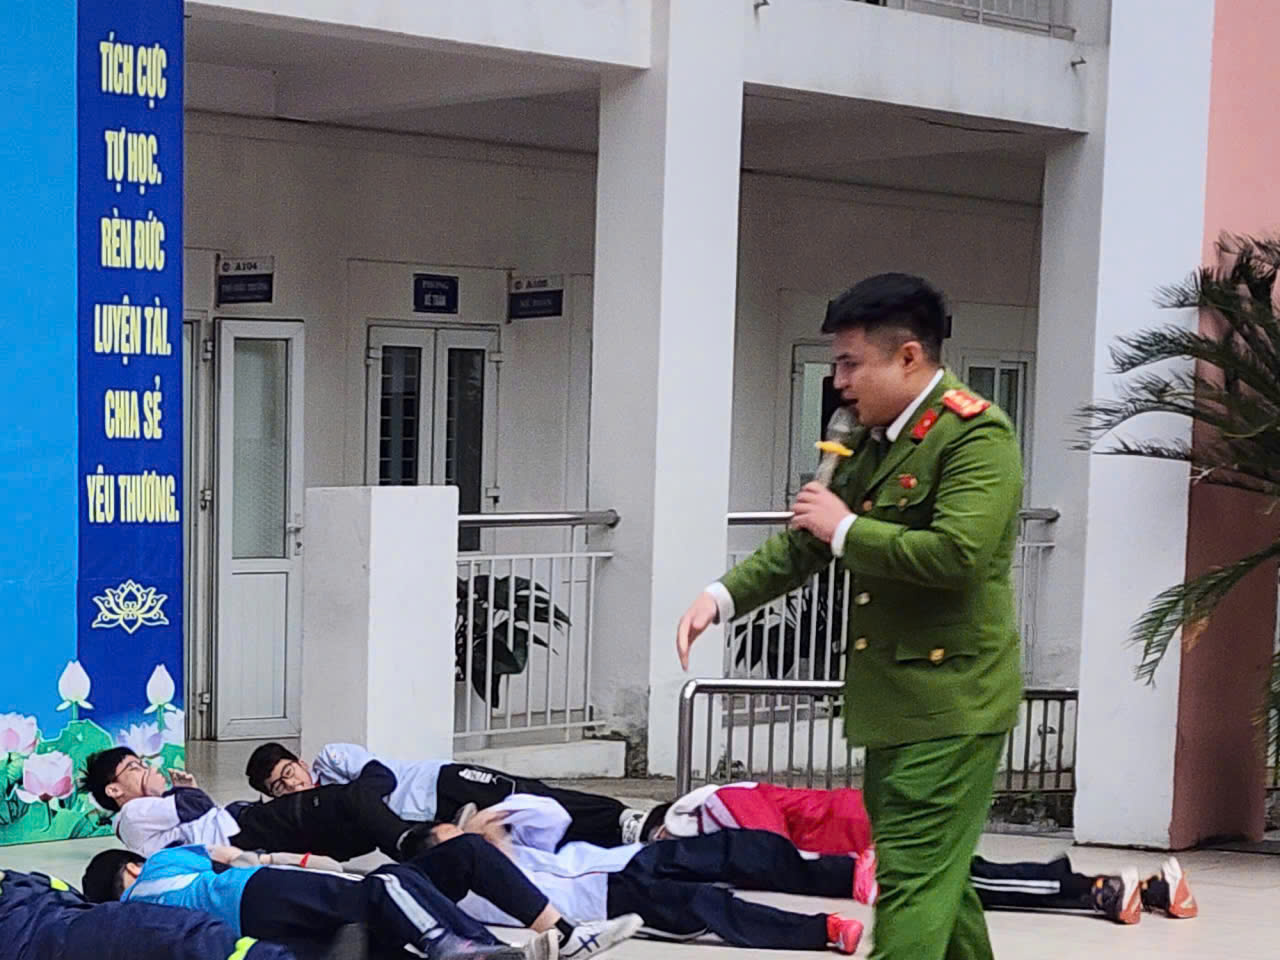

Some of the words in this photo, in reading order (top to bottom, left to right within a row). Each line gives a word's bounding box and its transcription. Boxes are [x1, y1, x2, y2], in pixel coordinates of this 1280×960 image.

[99, 31, 135, 96] TÍCH
[136, 42, 167, 109] CỰC
[104, 126, 126, 193] TỰ
[100, 207, 132, 270] RÈN
[134, 209, 166, 272] ĐỨC
[94, 294, 142, 366] LUYỆN
[104, 389, 141, 440] CHIA
[142, 375, 163, 440] SẺ
[86, 464, 116, 524] YÊU
[117, 470, 180, 524] THƯƠNG.
